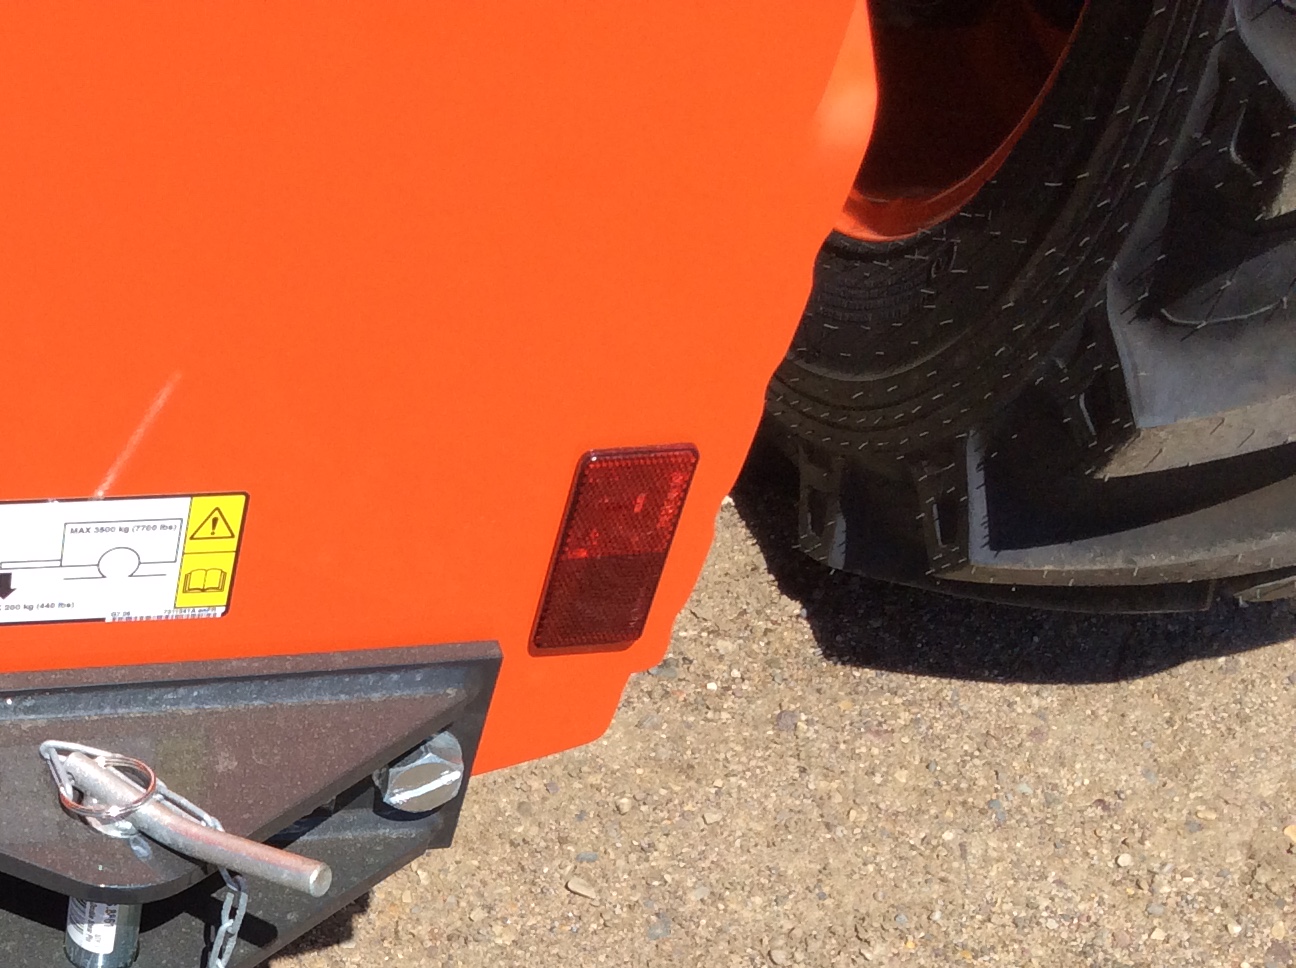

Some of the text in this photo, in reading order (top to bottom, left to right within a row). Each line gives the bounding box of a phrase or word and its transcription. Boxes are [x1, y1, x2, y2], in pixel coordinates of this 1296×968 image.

[94, 526, 116, 534] 3500
[119, 526, 130, 534] kg
[23, 603, 34, 612] kg
